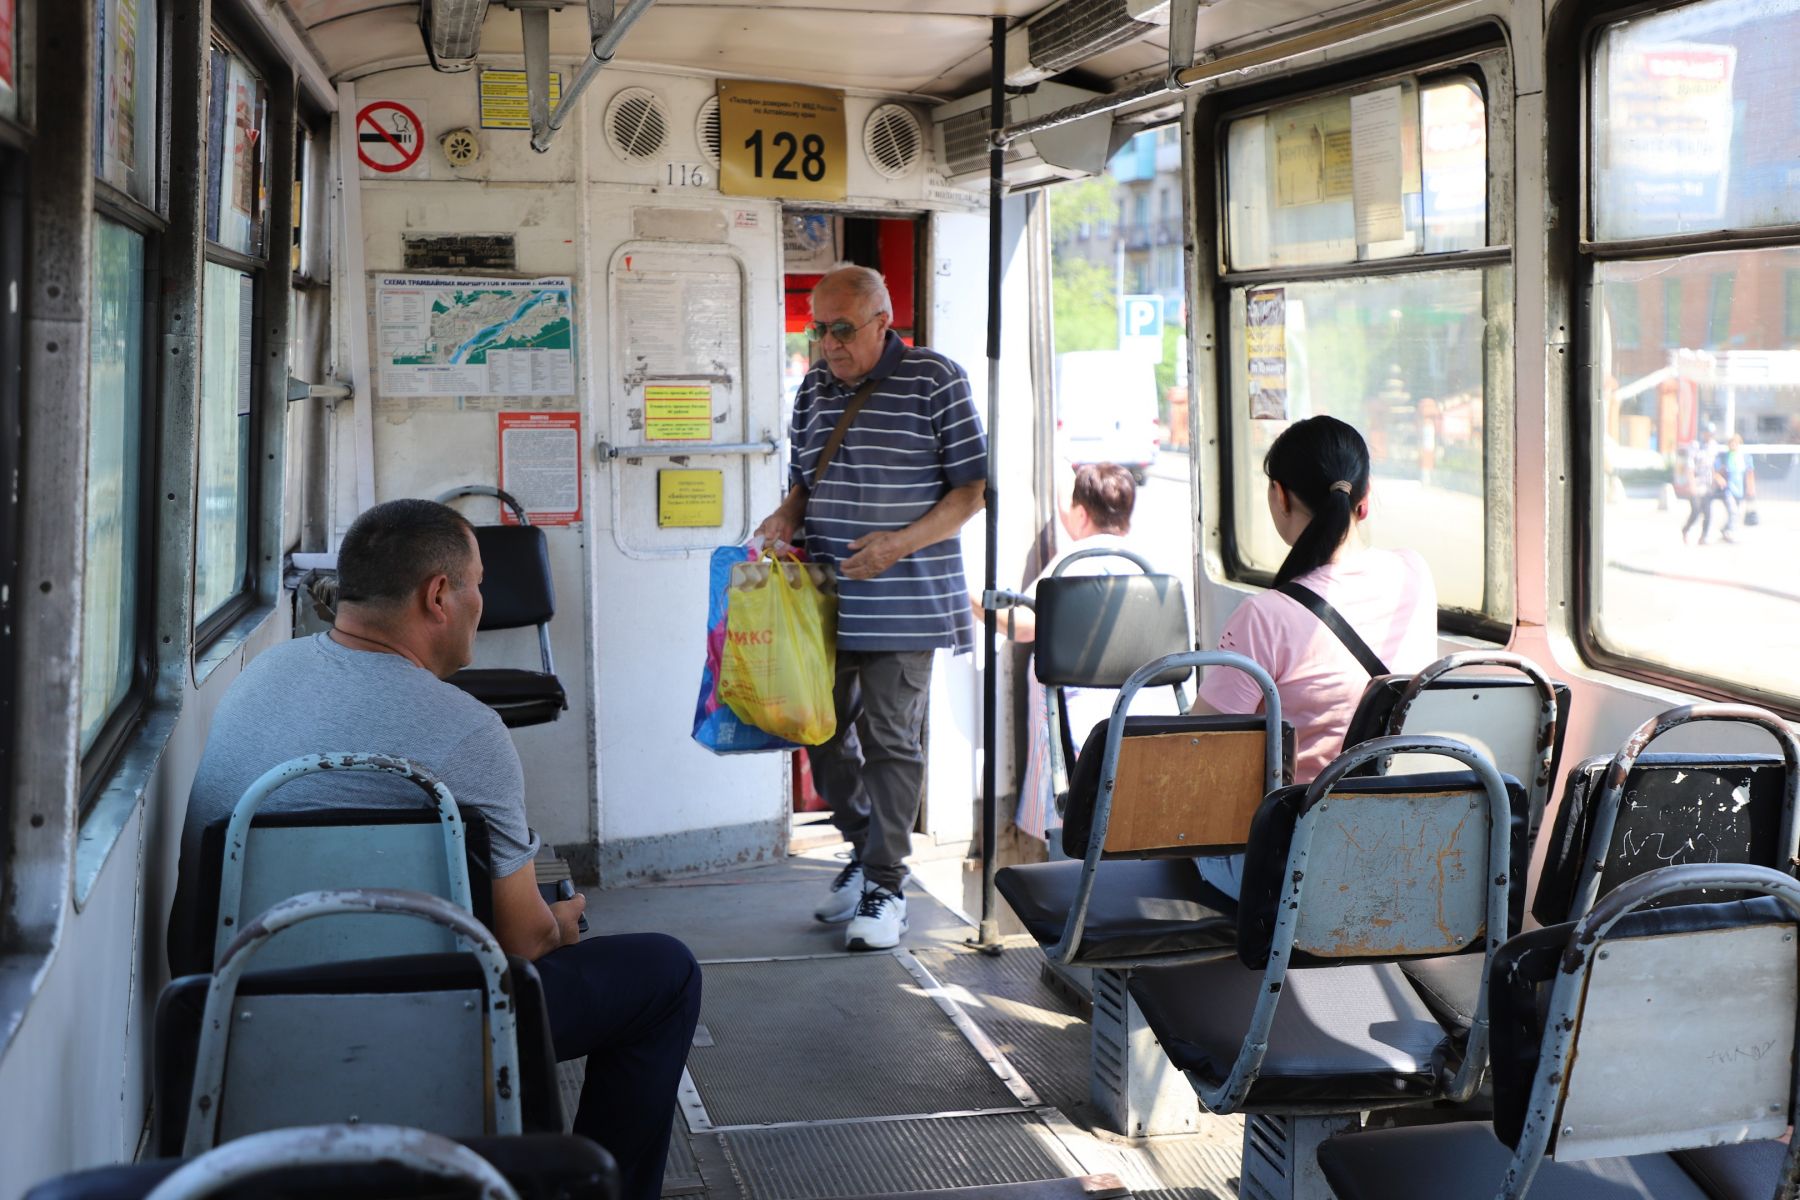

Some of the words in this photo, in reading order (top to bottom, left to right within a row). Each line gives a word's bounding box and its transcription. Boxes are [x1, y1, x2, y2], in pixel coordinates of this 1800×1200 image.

[745, 129, 826, 182] 128
[667, 164, 703, 187] 116
[1129, 301, 1155, 336] P
